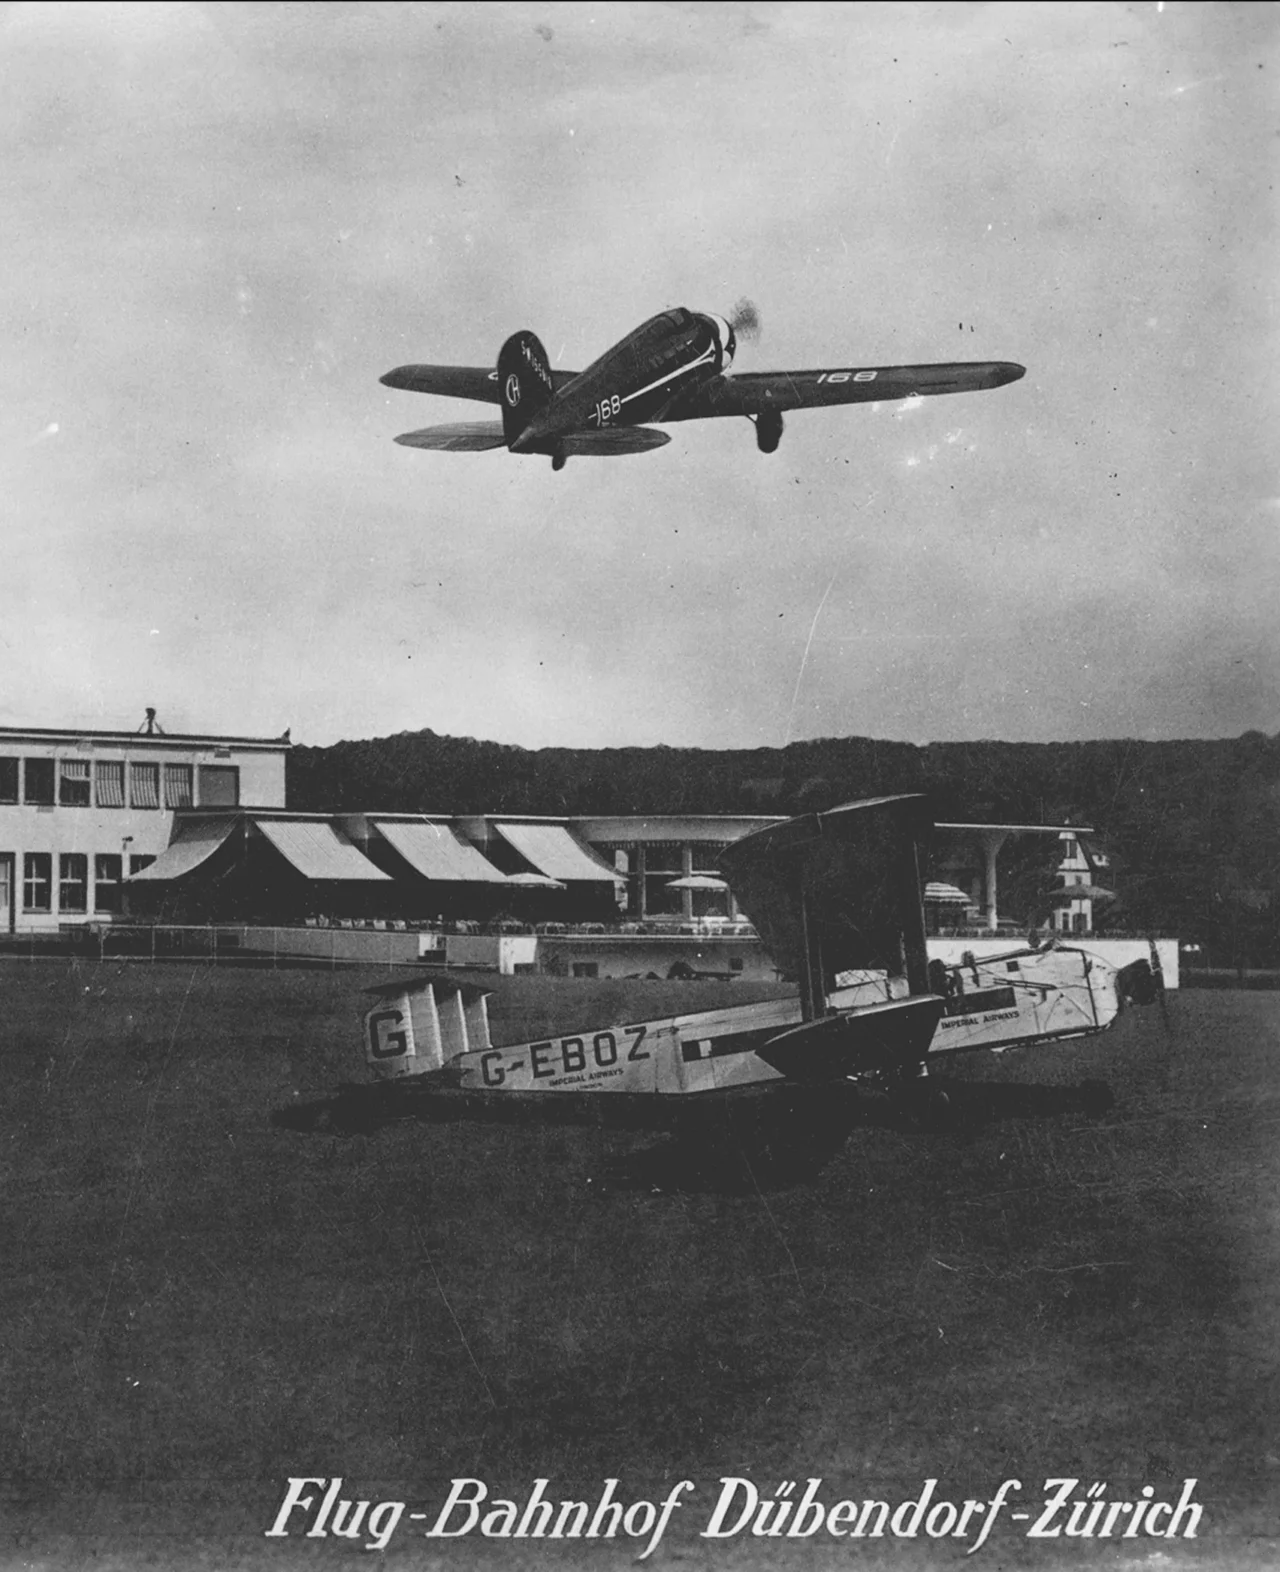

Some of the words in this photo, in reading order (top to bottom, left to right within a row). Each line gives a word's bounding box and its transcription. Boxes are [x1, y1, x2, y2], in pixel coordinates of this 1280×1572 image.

[816, 370, 878, 384] 168
[941, 1018, 979, 1029] IMPERIAL
[983, 1010, 1020, 1023] AIRWAYS
[370, 1010, 407, 1059] G
[481, 1026, 651, 1087] G-EBOZ
[549, 1074, 586, 1087] IMPERIAL
[588, 1067, 625, 1080] AIRWAYS
